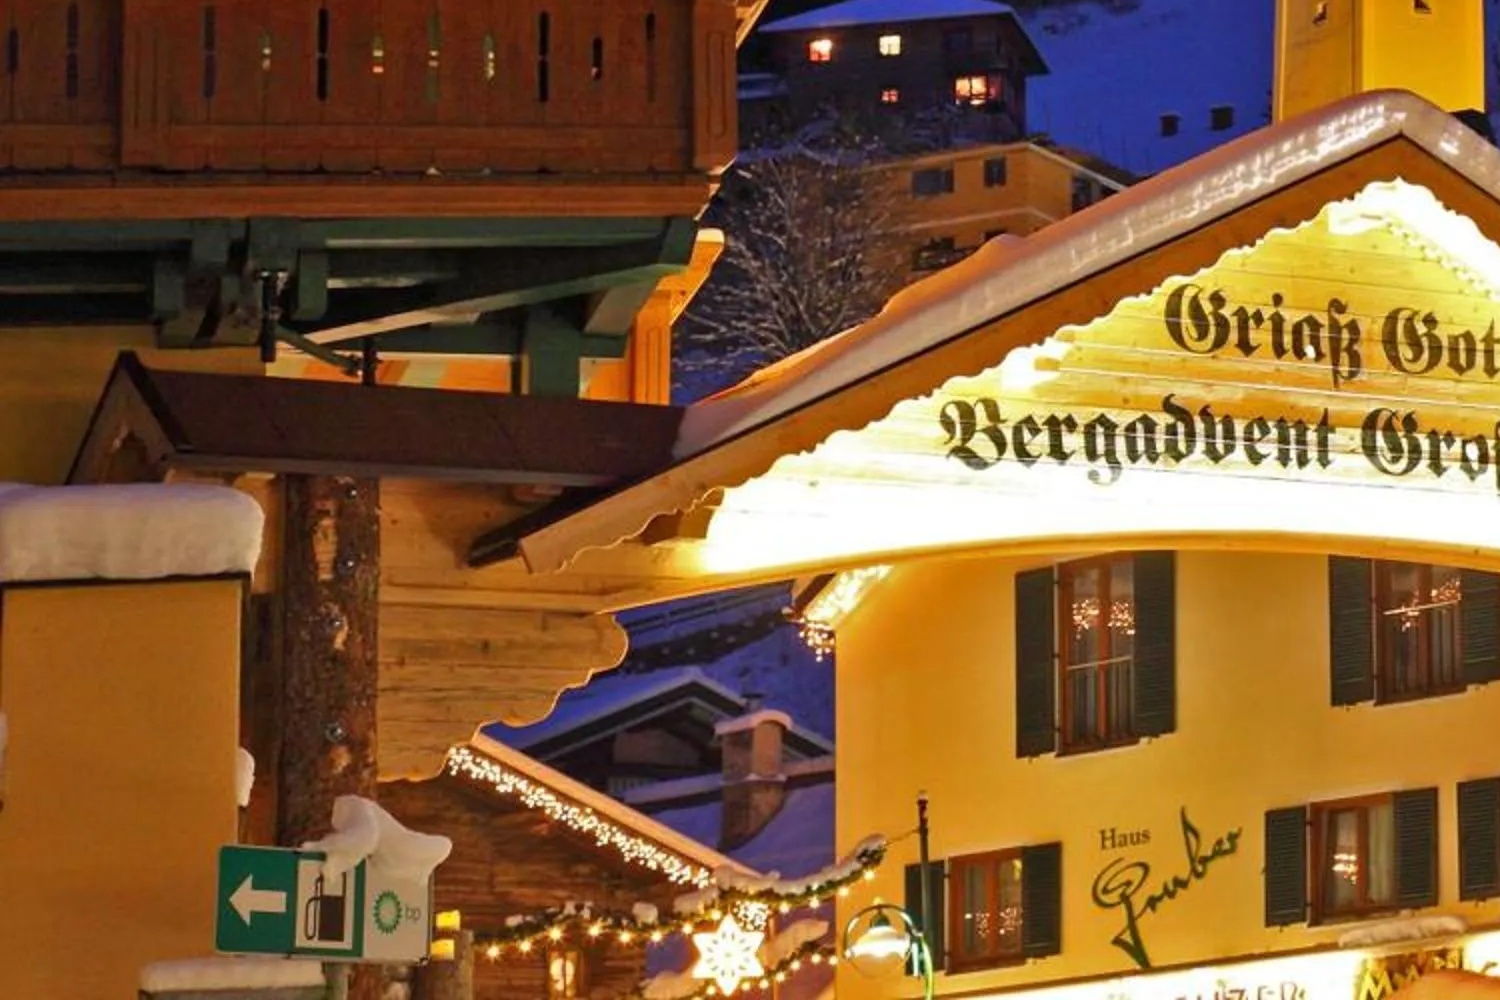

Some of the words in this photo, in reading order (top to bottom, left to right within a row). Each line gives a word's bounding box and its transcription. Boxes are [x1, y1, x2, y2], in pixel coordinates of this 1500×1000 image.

[1164, 283, 1362, 388] Griaß
[939, 393, 1337, 485] Bergadvent
[1100, 827, 1151, 850] Haus
